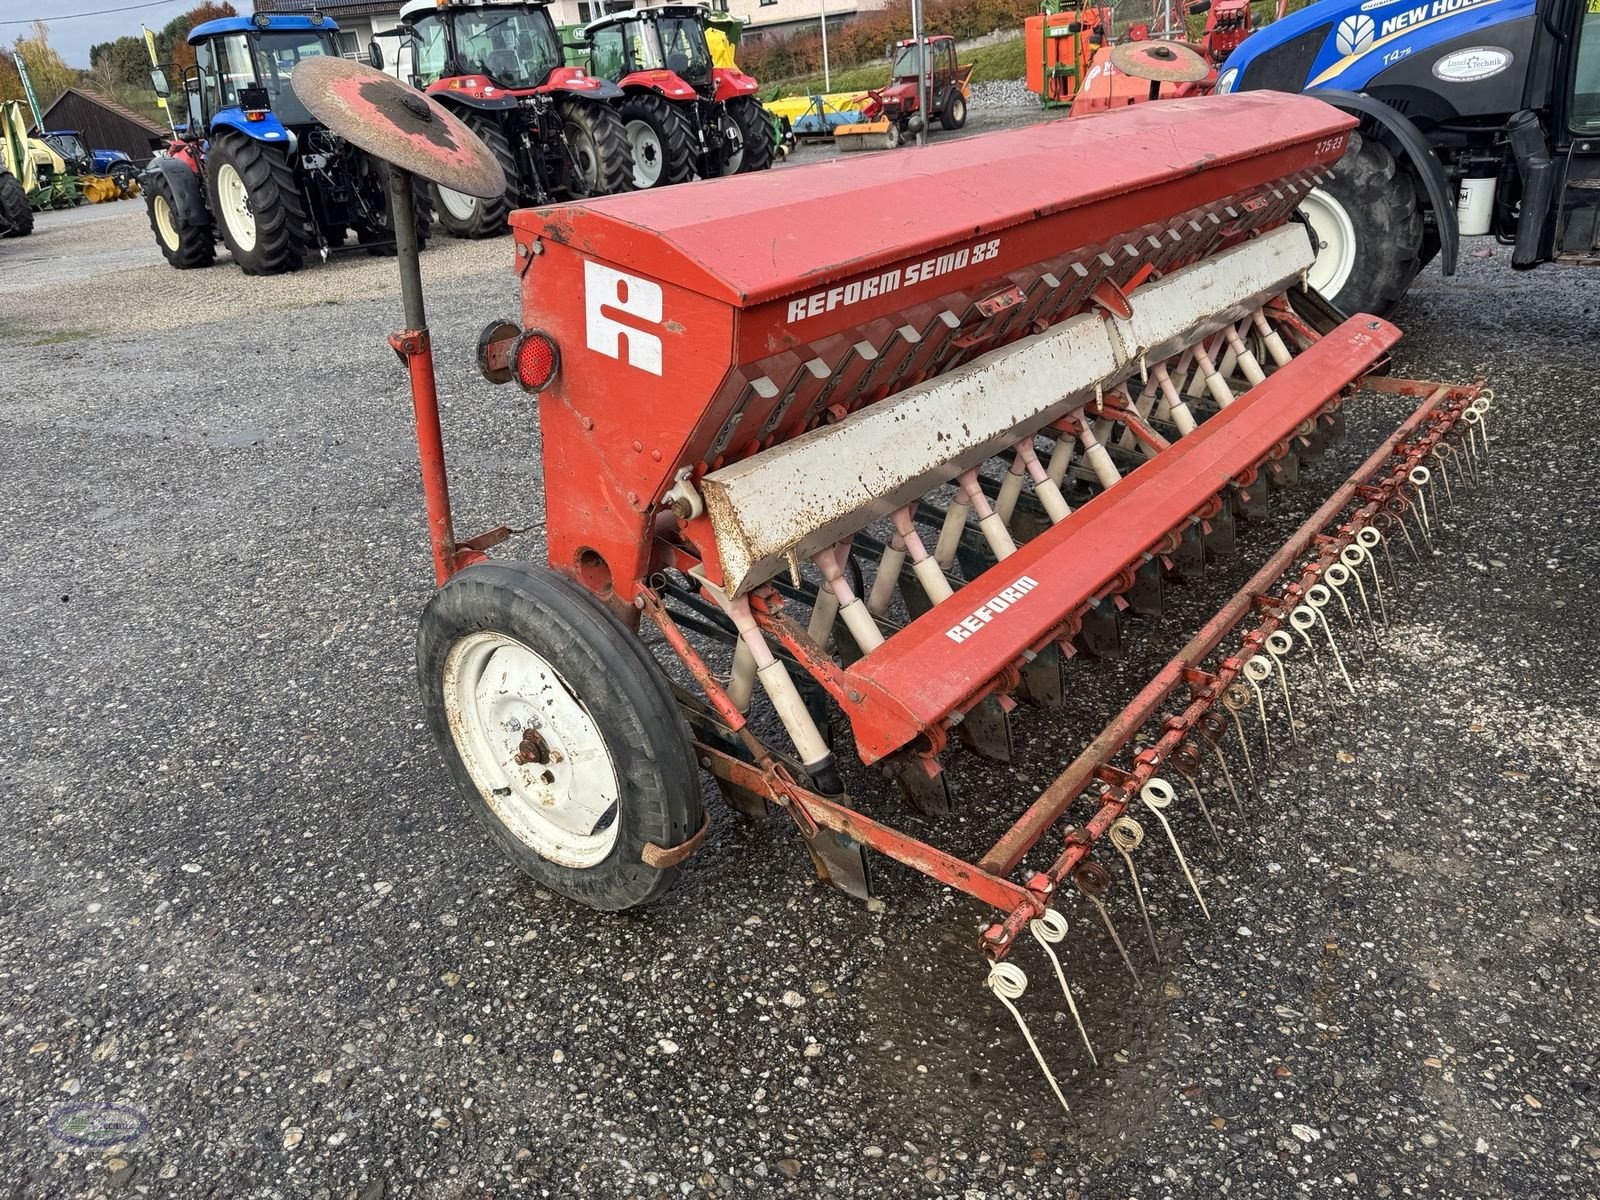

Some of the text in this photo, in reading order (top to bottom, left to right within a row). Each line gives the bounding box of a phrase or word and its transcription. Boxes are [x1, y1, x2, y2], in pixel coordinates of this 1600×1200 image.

[1381, 4, 1429, 36] NEW
[787, 269, 901, 324] REFORM
[904, 248, 969, 287] SEMO
[944, 575, 1040, 645] REFORM
